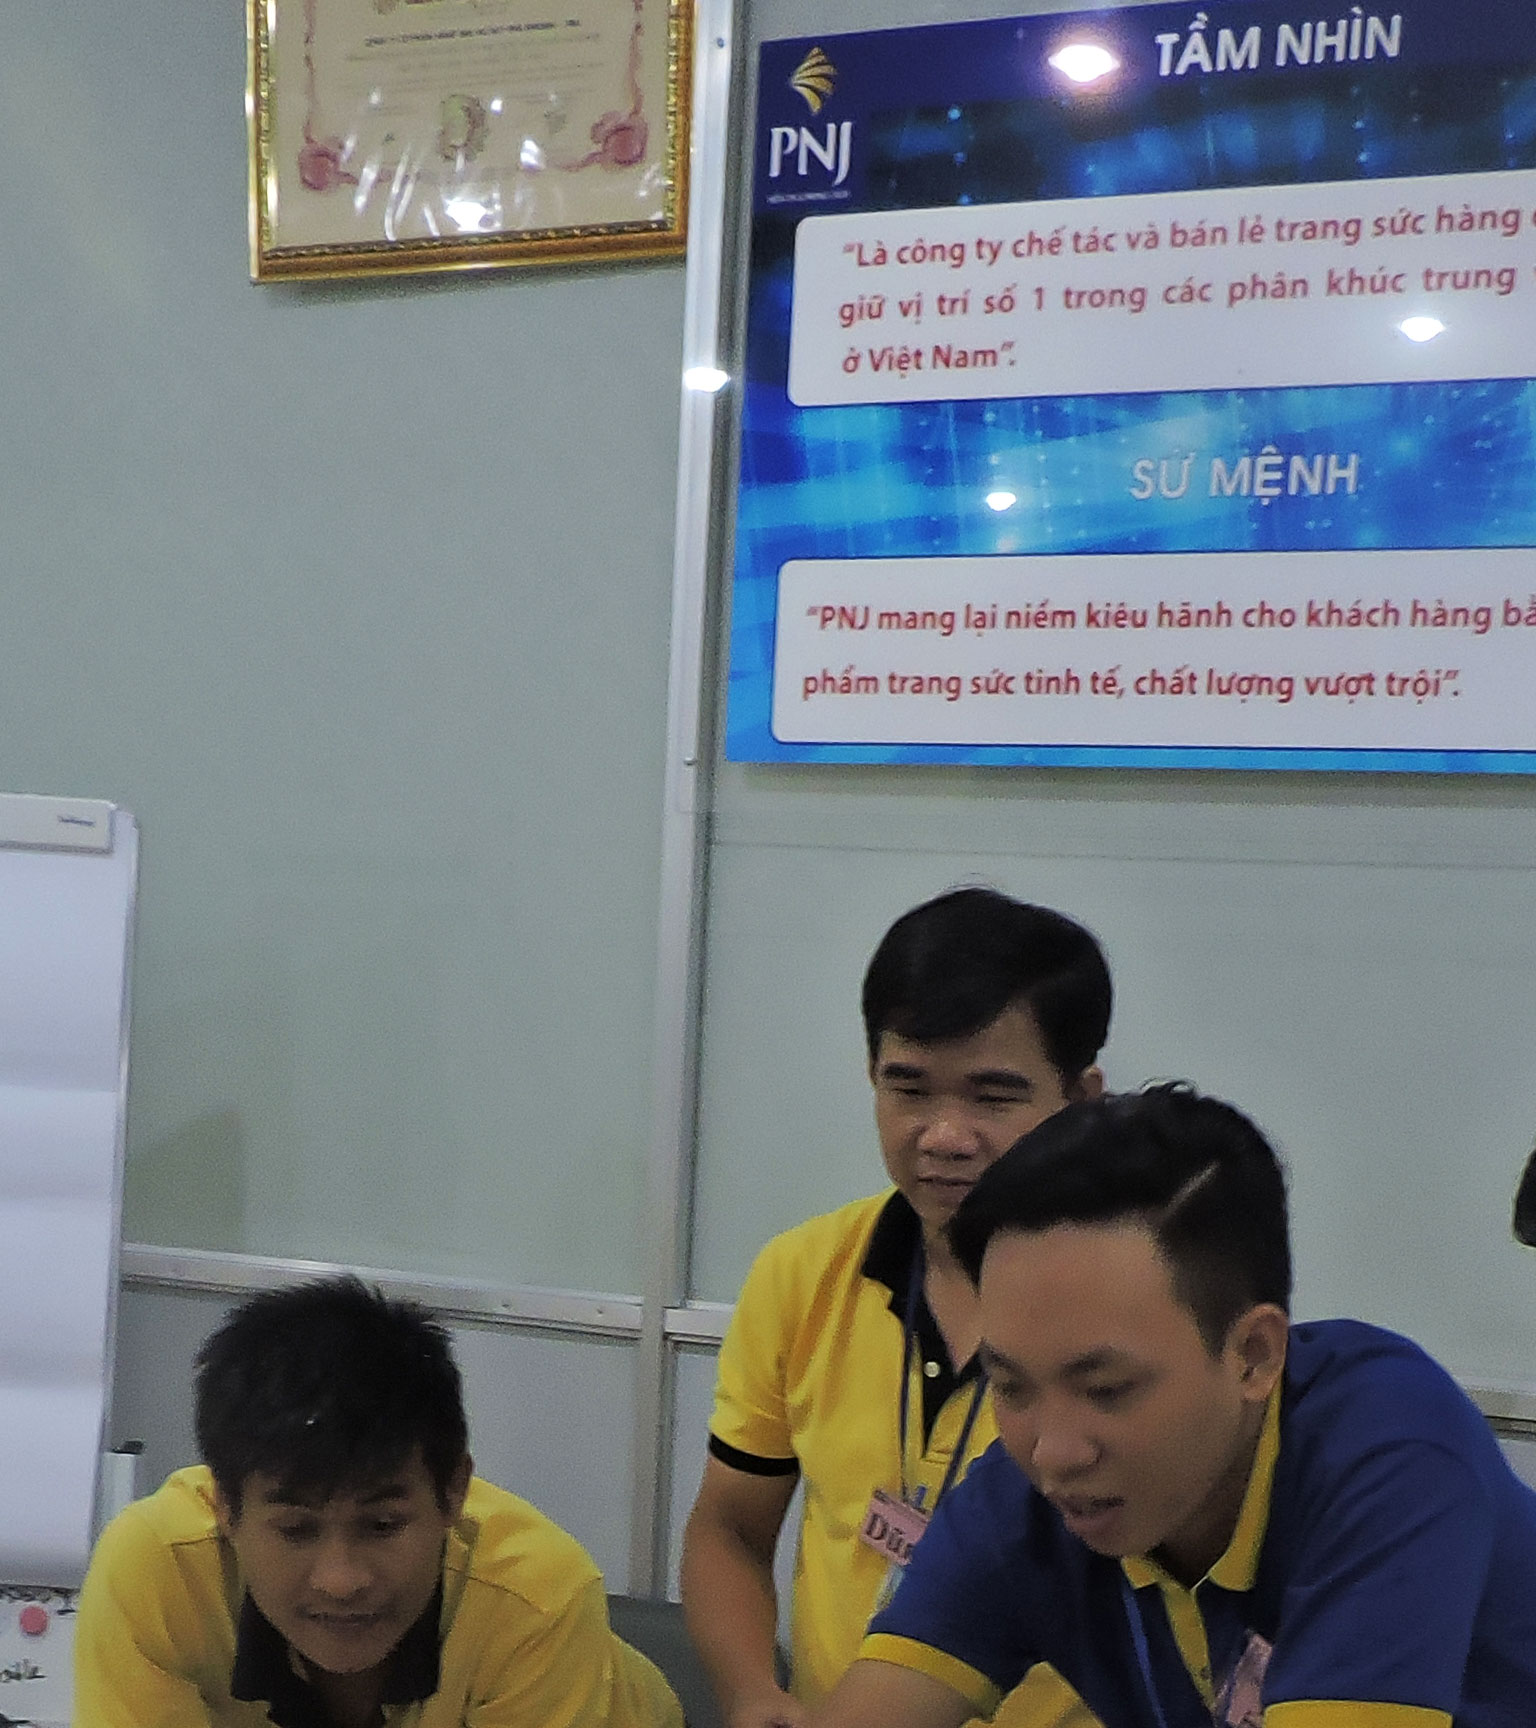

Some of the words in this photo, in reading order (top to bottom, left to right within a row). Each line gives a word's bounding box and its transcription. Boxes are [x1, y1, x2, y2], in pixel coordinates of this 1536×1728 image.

[1155, 12, 1261, 76] TẦM
[1276, 6, 1402, 66] NHÌN
[769, 121, 854, 186] PNJ
[895, 237, 967, 270] công
[974, 237, 1005, 268] ty
[1010, 224, 1067, 259] chế
[1071, 225, 1119, 255] tác
[1124, 222, 1161, 251] và
[1168, 219, 1229, 249] bán
[1274, 217, 1363, 247] trang
[1370, 206, 1427, 239] sức
[1434, 203, 1524, 238] hàng
[897, 291, 924, 326] vị
[936, 288, 972, 317] trí
[982, 282, 1018, 315] số
[1033, 286, 1045, 312] 1
[1061, 286, 1149, 315] trong
[1161, 275, 1213, 305] các
[1226, 271, 1310, 309] phân
[1325, 265, 1407, 297] khúc
[1421, 267, 1519, 297] trung
[867, 344, 925, 380] Việt
[1209, 444, 1359, 506] MỆNH
[876, 610, 957, 638] mang
[963, 602, 998, 638] lại
[1084, 600, 1150, 630] kiêu
[1241, 599, 1298, 629] cho
[1304, 598, 1402, 629] khách
[1408, 598, 1494, 636] hàng
[886, 671, 964, 703] trang
[968, 667, 1018, 696] sức
[1088, 663, 1127, 700] tế,
[1132, 663, 1199, 696] chất
[1205, 667, 1296, 705] lượng
[1303, 671, 1378, 705] vượt
